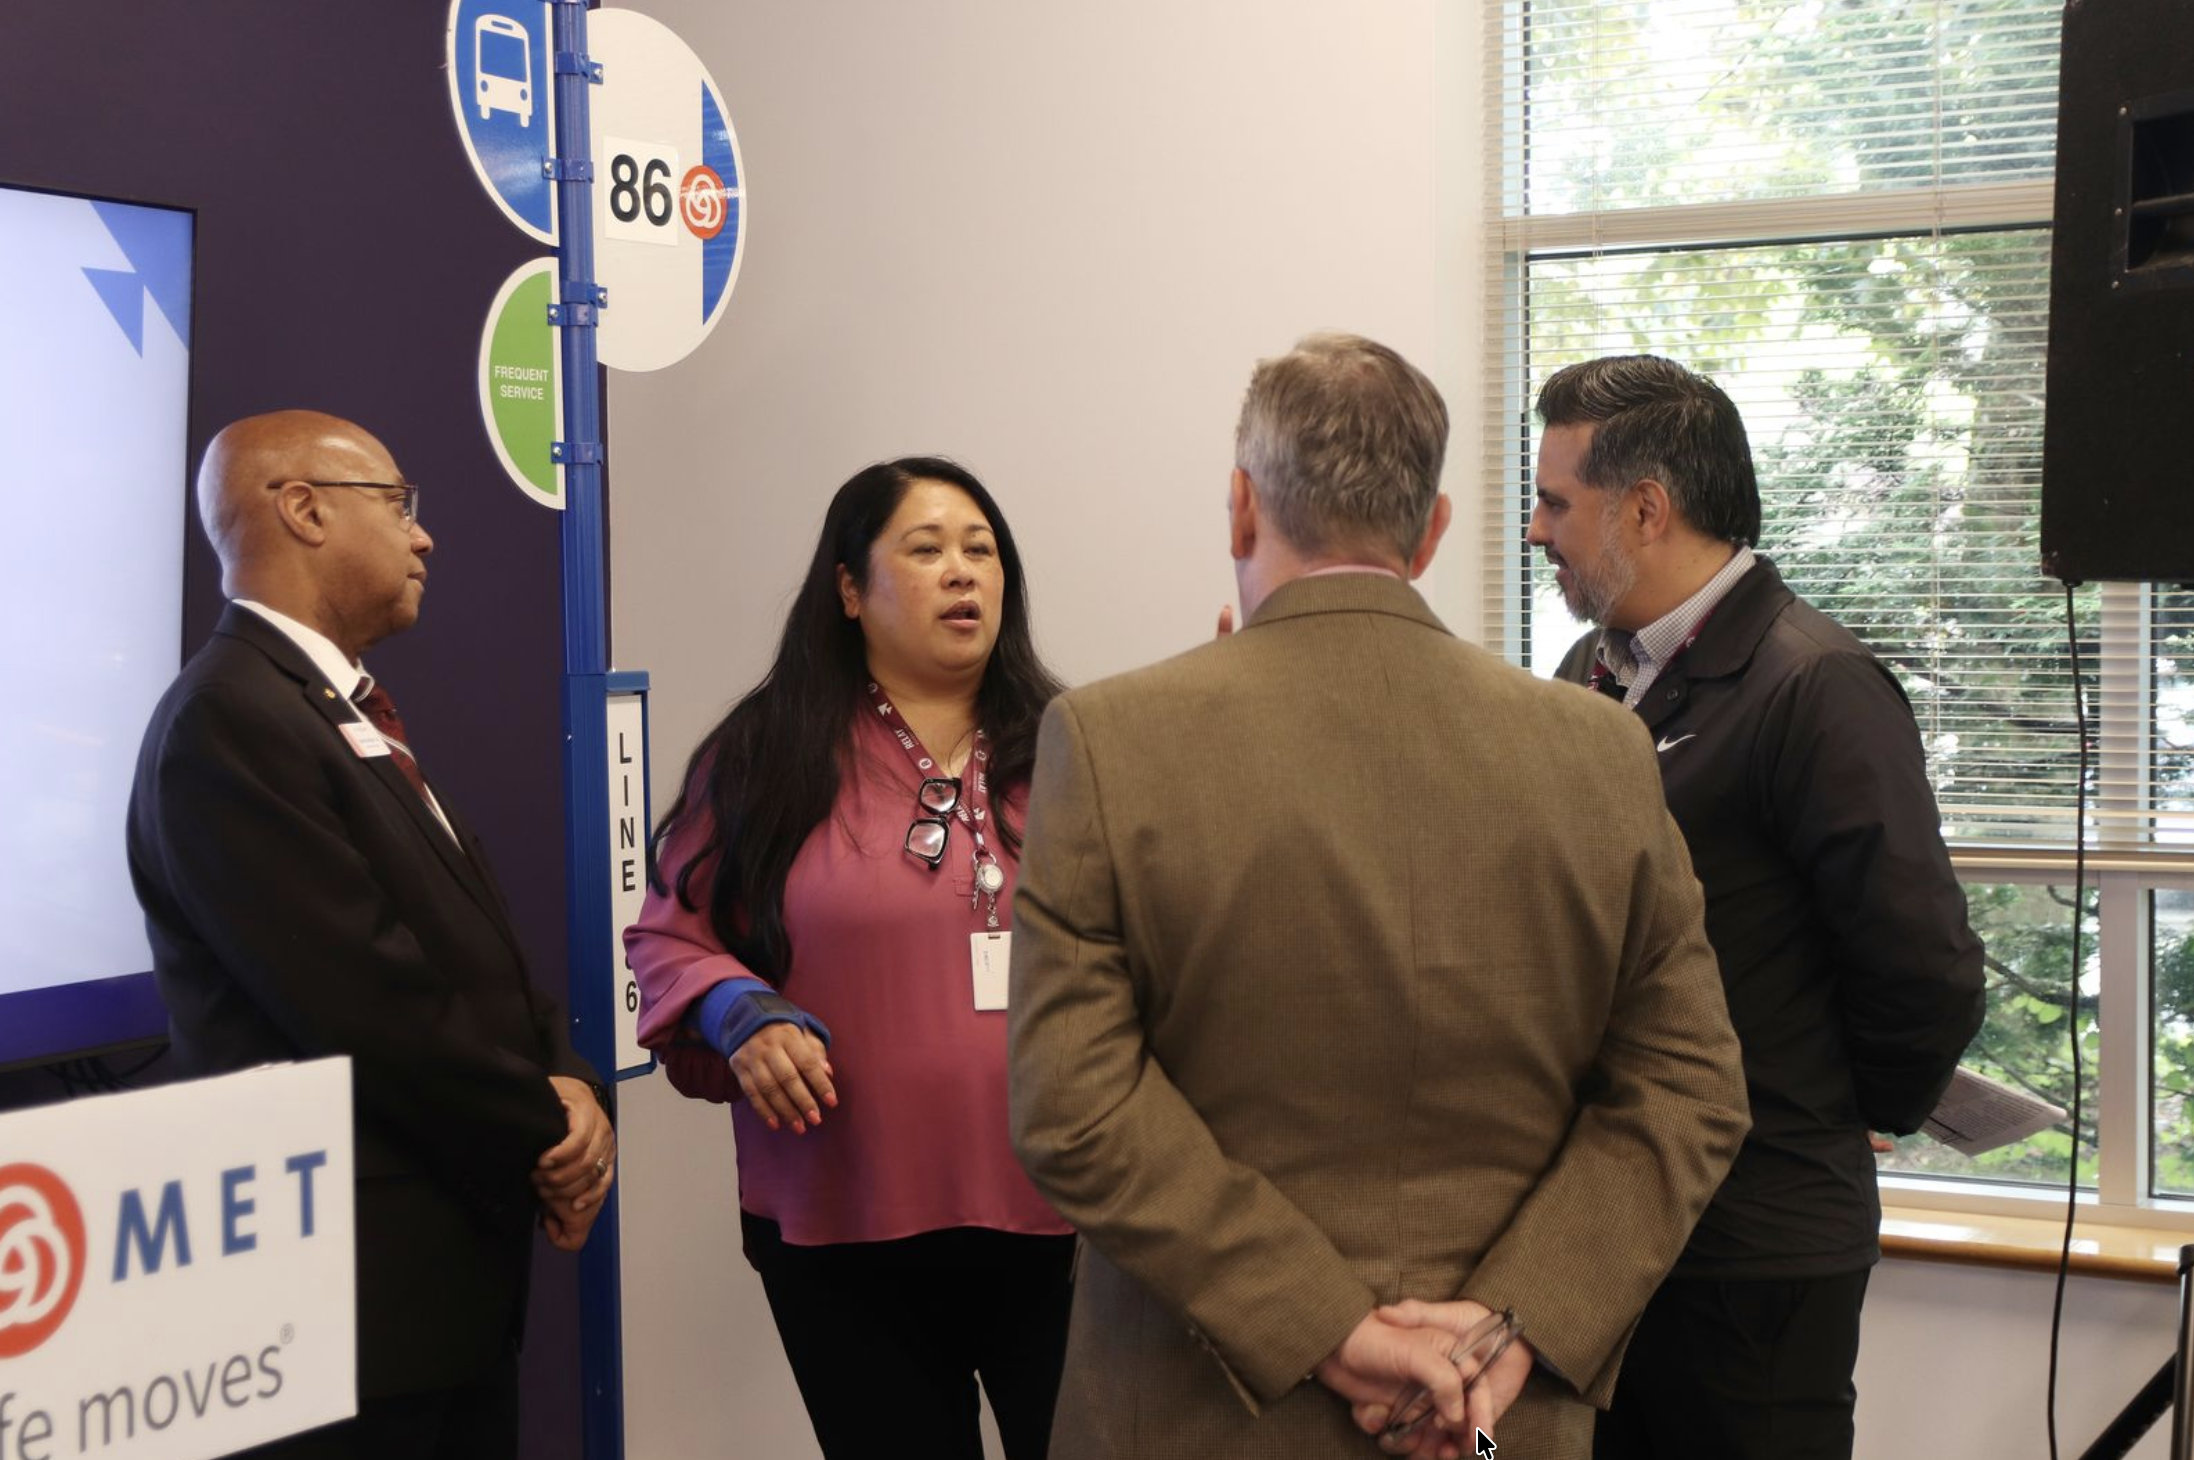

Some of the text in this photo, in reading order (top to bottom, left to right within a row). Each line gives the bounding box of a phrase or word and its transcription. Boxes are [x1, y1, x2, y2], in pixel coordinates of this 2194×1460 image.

[610, 154, 673, 227] 86
[494, 365, 549, 382] FREQUENT
[500, 384, 544, 400] SERVICE
[619, 732, 636, 893] LINE
[112, 1149, 327, 1284] MET
